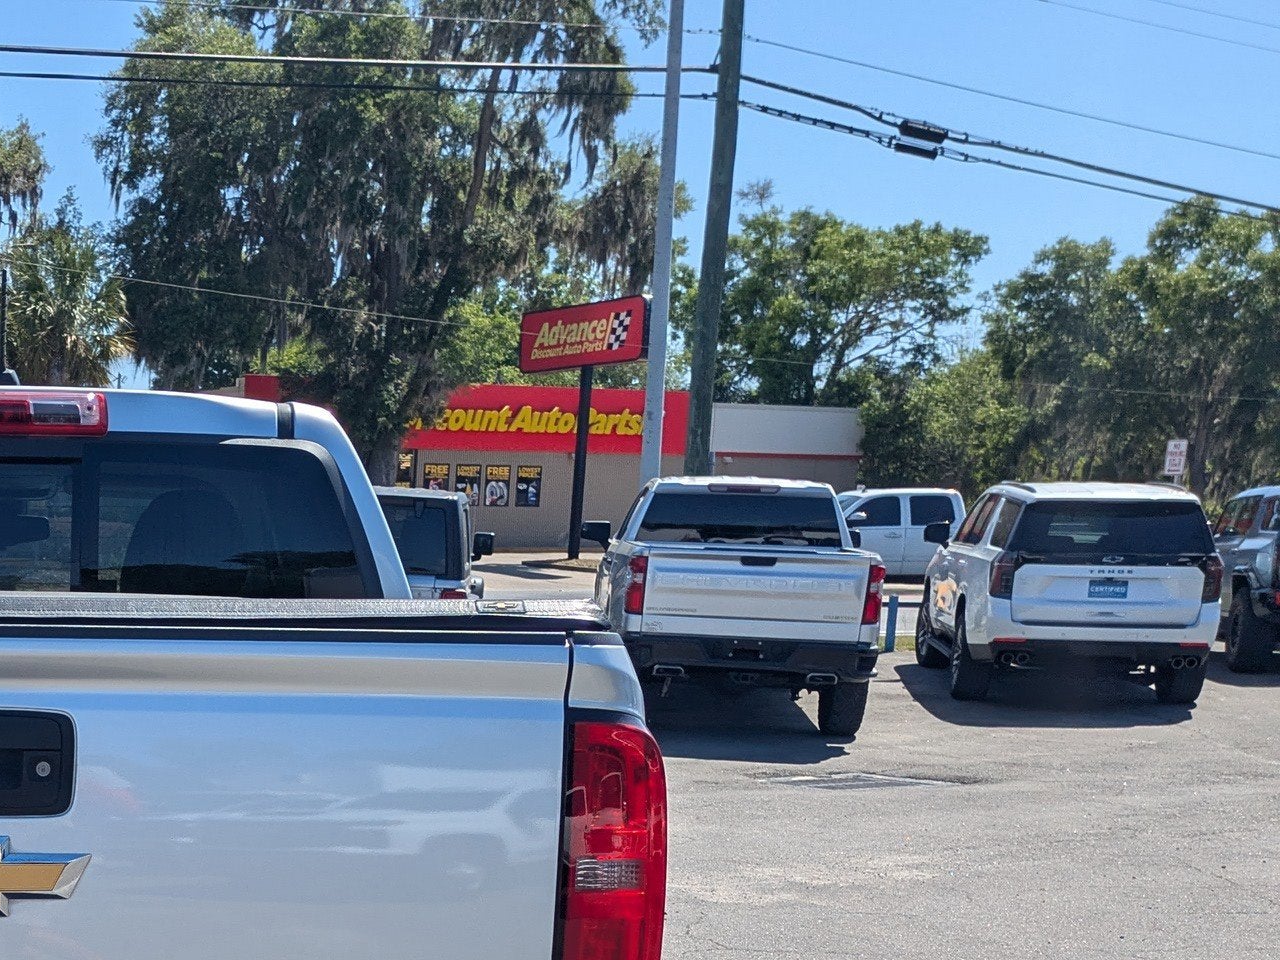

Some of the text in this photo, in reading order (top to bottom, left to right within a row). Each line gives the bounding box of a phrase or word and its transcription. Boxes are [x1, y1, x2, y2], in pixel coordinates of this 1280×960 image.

[534, 318, 608, 348] Advance
[531, 341, 604, 360] Discount Auto Parts
[509, 405, 576, 434] Auto
[425, 464, 449, 475] FREE
[486, 466, 510, 476] FREE
